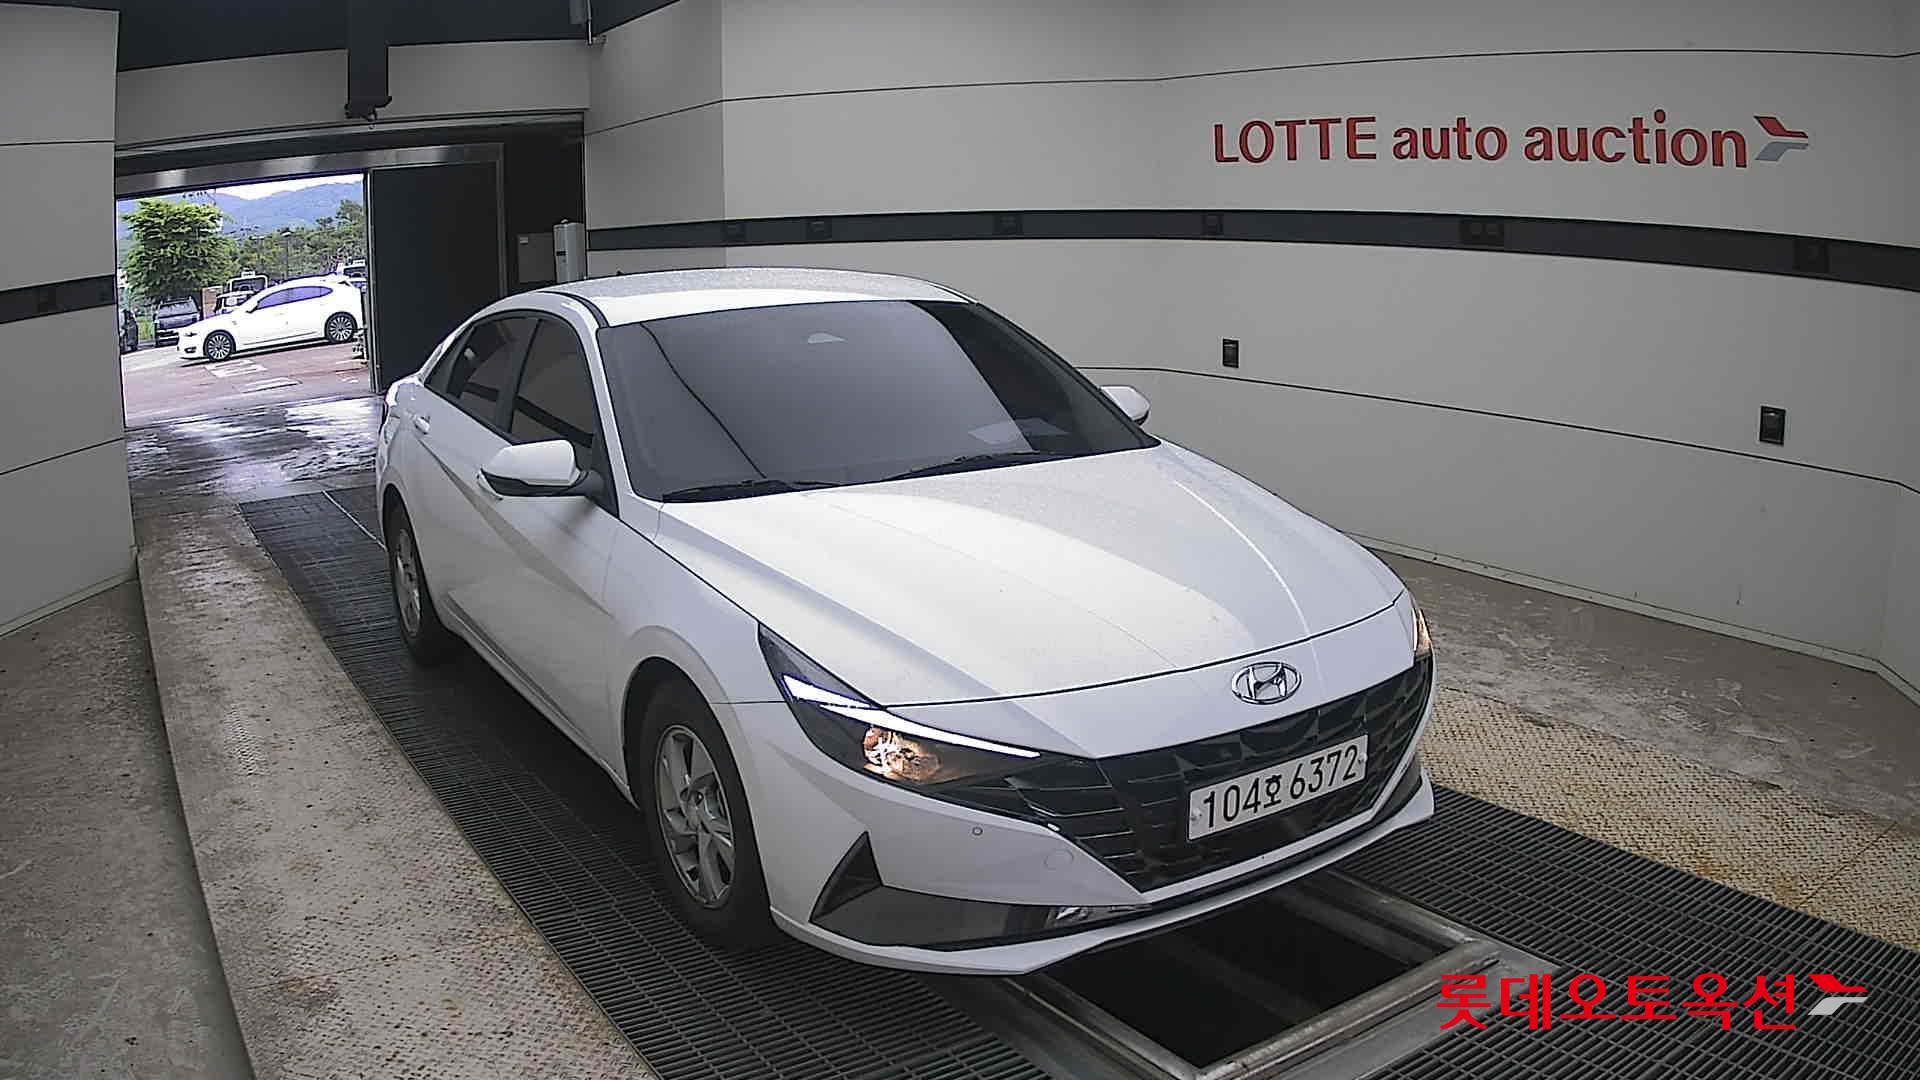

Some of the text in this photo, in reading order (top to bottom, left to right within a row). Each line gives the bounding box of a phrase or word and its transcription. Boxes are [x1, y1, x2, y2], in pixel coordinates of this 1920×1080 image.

[1213, 109, 1748, 168] LOTTE auto auction
